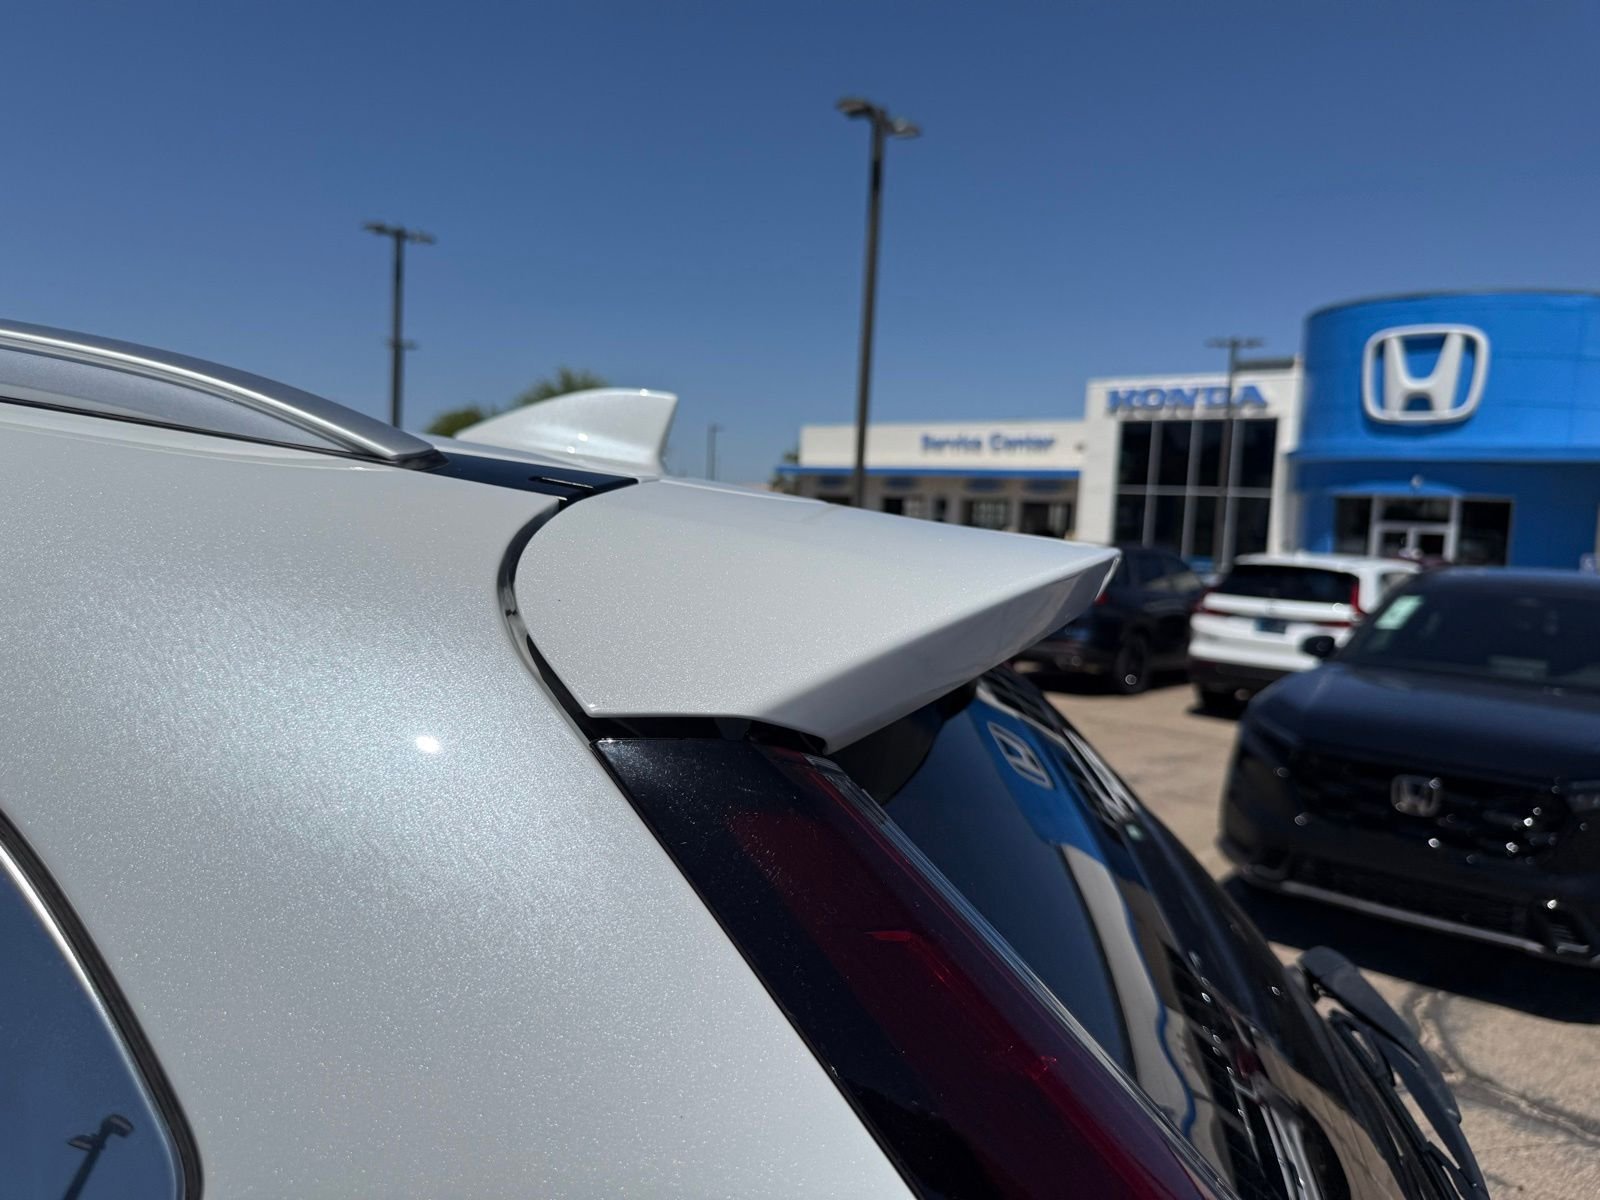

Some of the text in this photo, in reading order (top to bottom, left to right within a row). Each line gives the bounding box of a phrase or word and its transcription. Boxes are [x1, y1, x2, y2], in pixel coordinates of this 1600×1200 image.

[1107, 385, 1268, 413] HONDA
[920, 432, 1056, 453] Service Center
